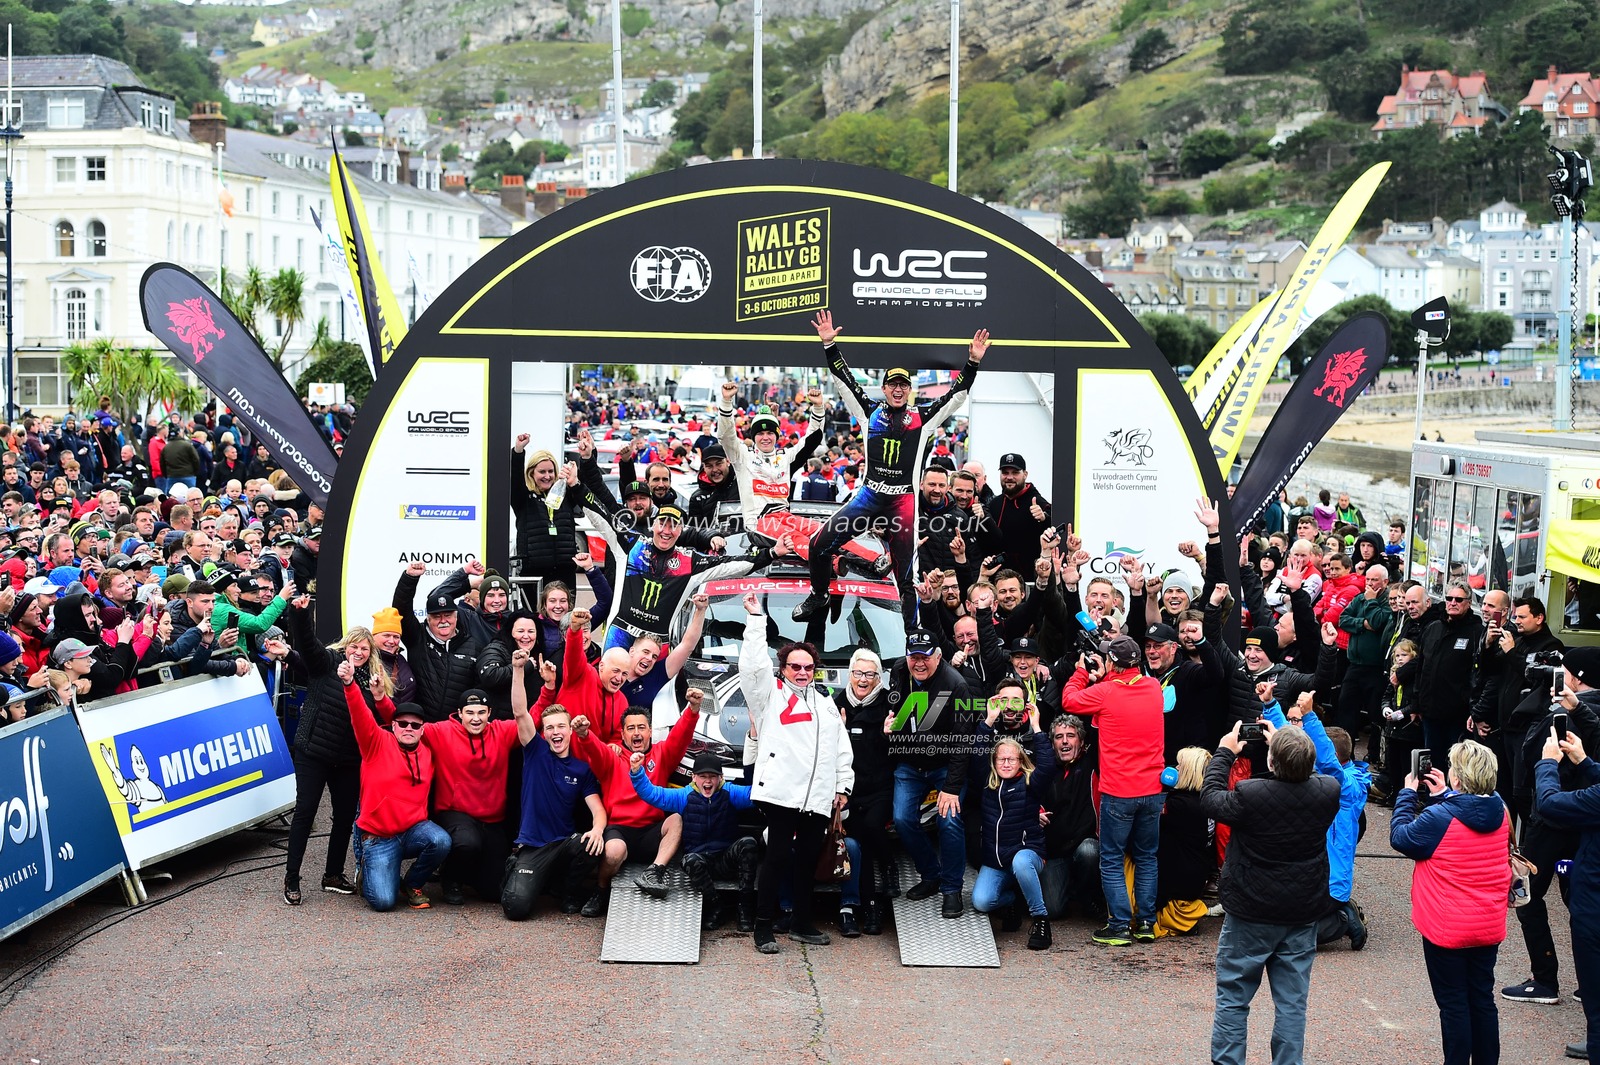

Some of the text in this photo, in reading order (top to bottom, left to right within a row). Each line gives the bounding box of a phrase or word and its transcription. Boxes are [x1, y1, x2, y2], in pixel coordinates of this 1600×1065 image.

[746, 217, 821, 253] WALES
[746, 245, 820, 274] RALLY GB
[749, 269, 817, 288] A WORLD APART
[881, 287, 931, 295] WORLD
[935, 288, 983, 296] RALLY
[744, 292, 820, 315] 3-6 OCTOBER 2019
[856, 299, 983, 308] CHAMPIONSHIP
[1092, 473, 1158, 482] Llywodraeth Cymru
[1093, 482, 1157, 491] Welsh Government
[420, 509, 470, 517] MICHELIN
[424, 568, 456, 577] atches
[838, 584, 866, 593] LIVE
[159, 724, 273, 788] MICHELIN
